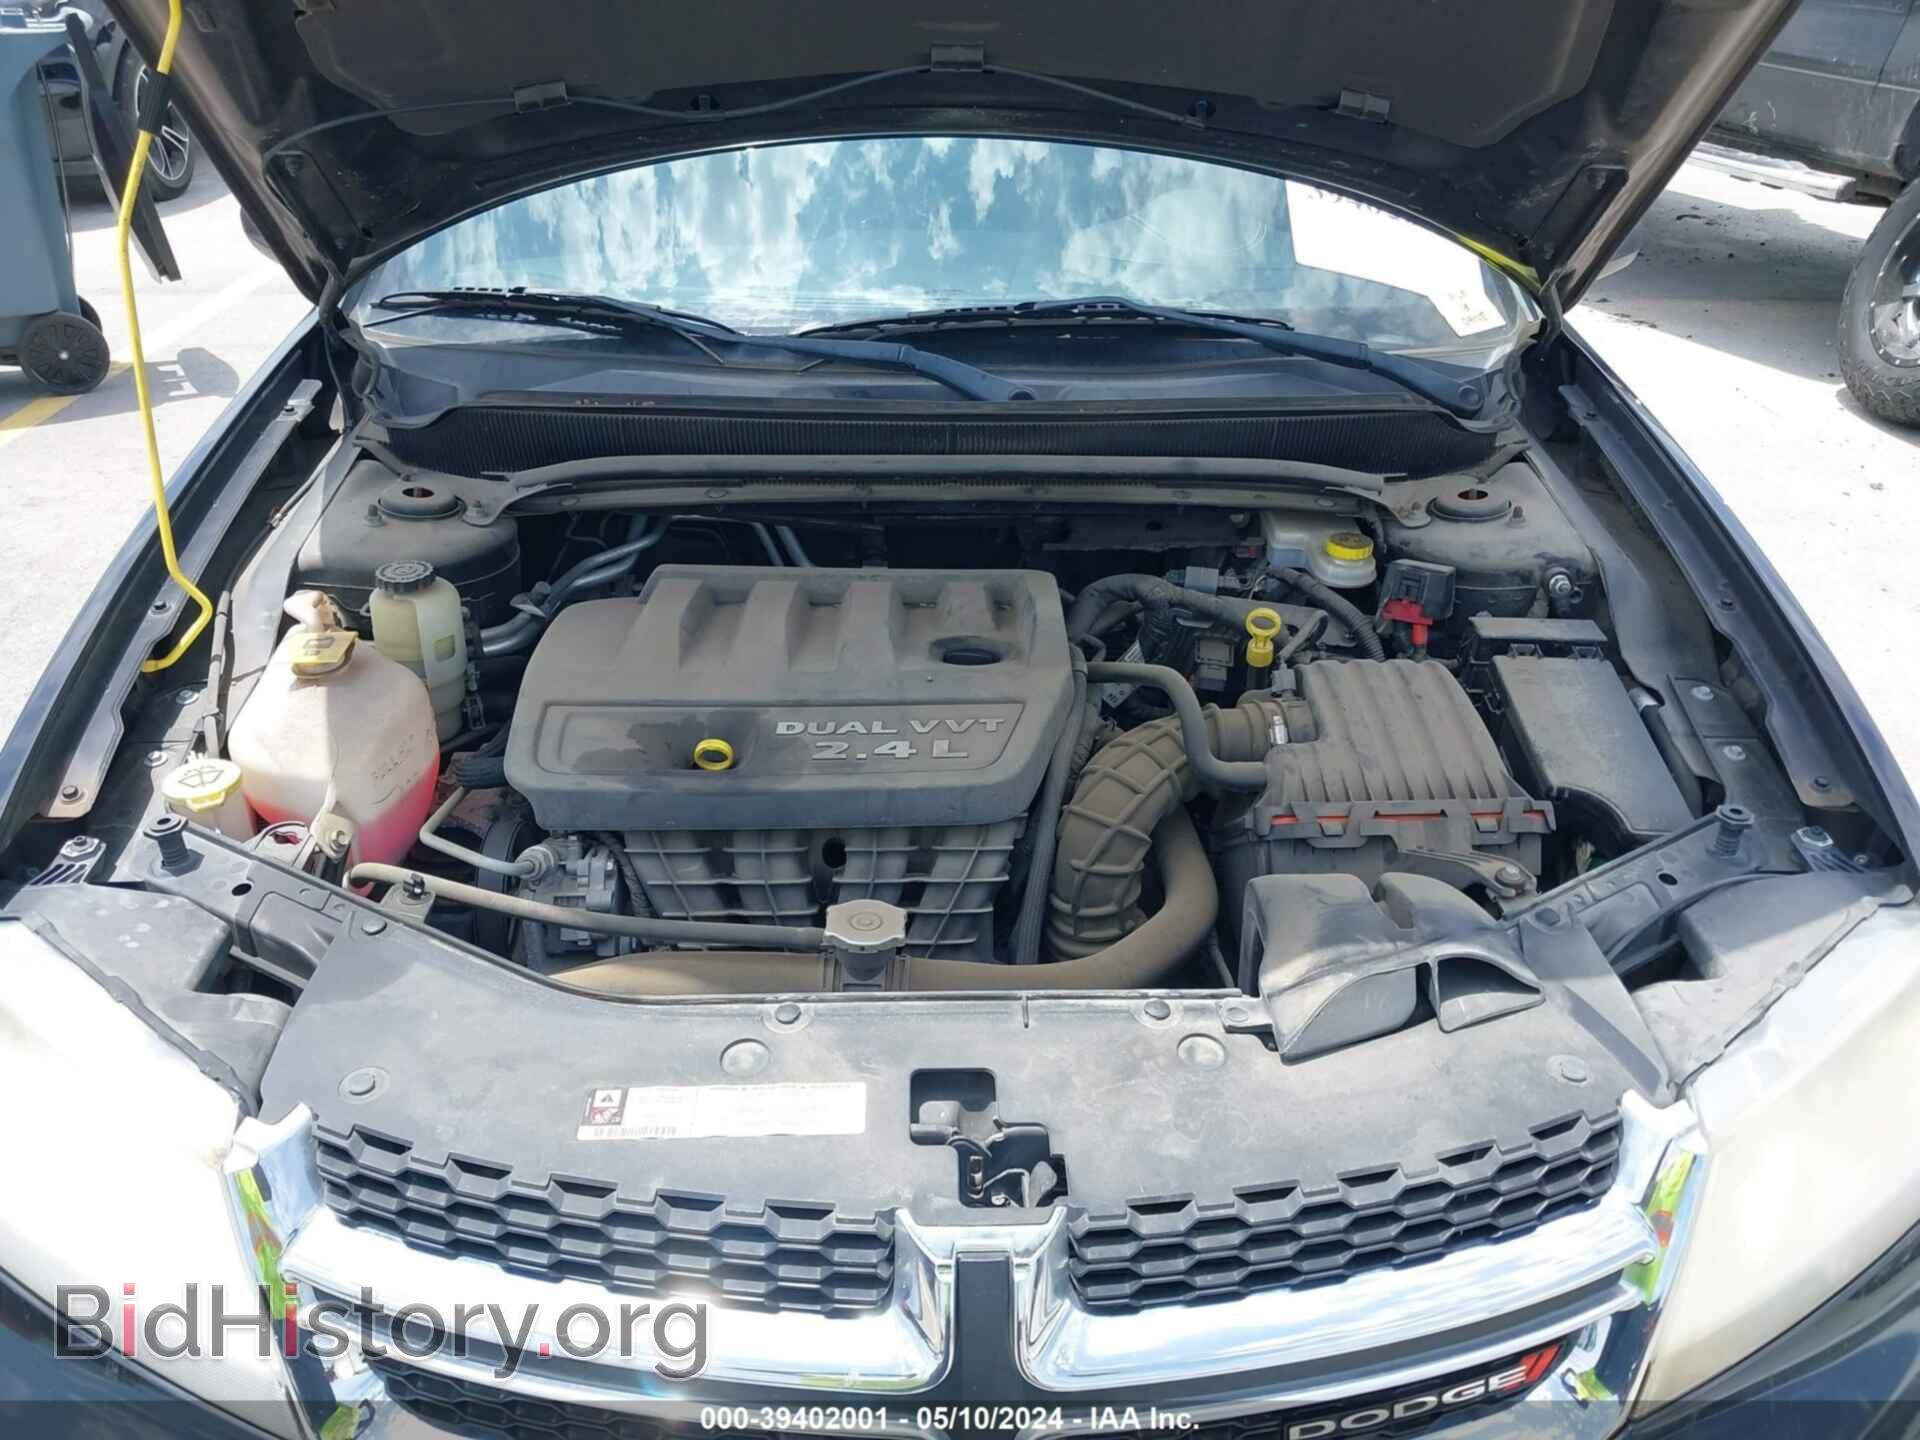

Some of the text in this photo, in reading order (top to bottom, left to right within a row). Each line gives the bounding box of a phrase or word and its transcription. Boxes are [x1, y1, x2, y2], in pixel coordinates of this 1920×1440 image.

[775, 717, 1005, 735] DUAL VVT
[1289, 1366, 1527, 1440] DODGE
